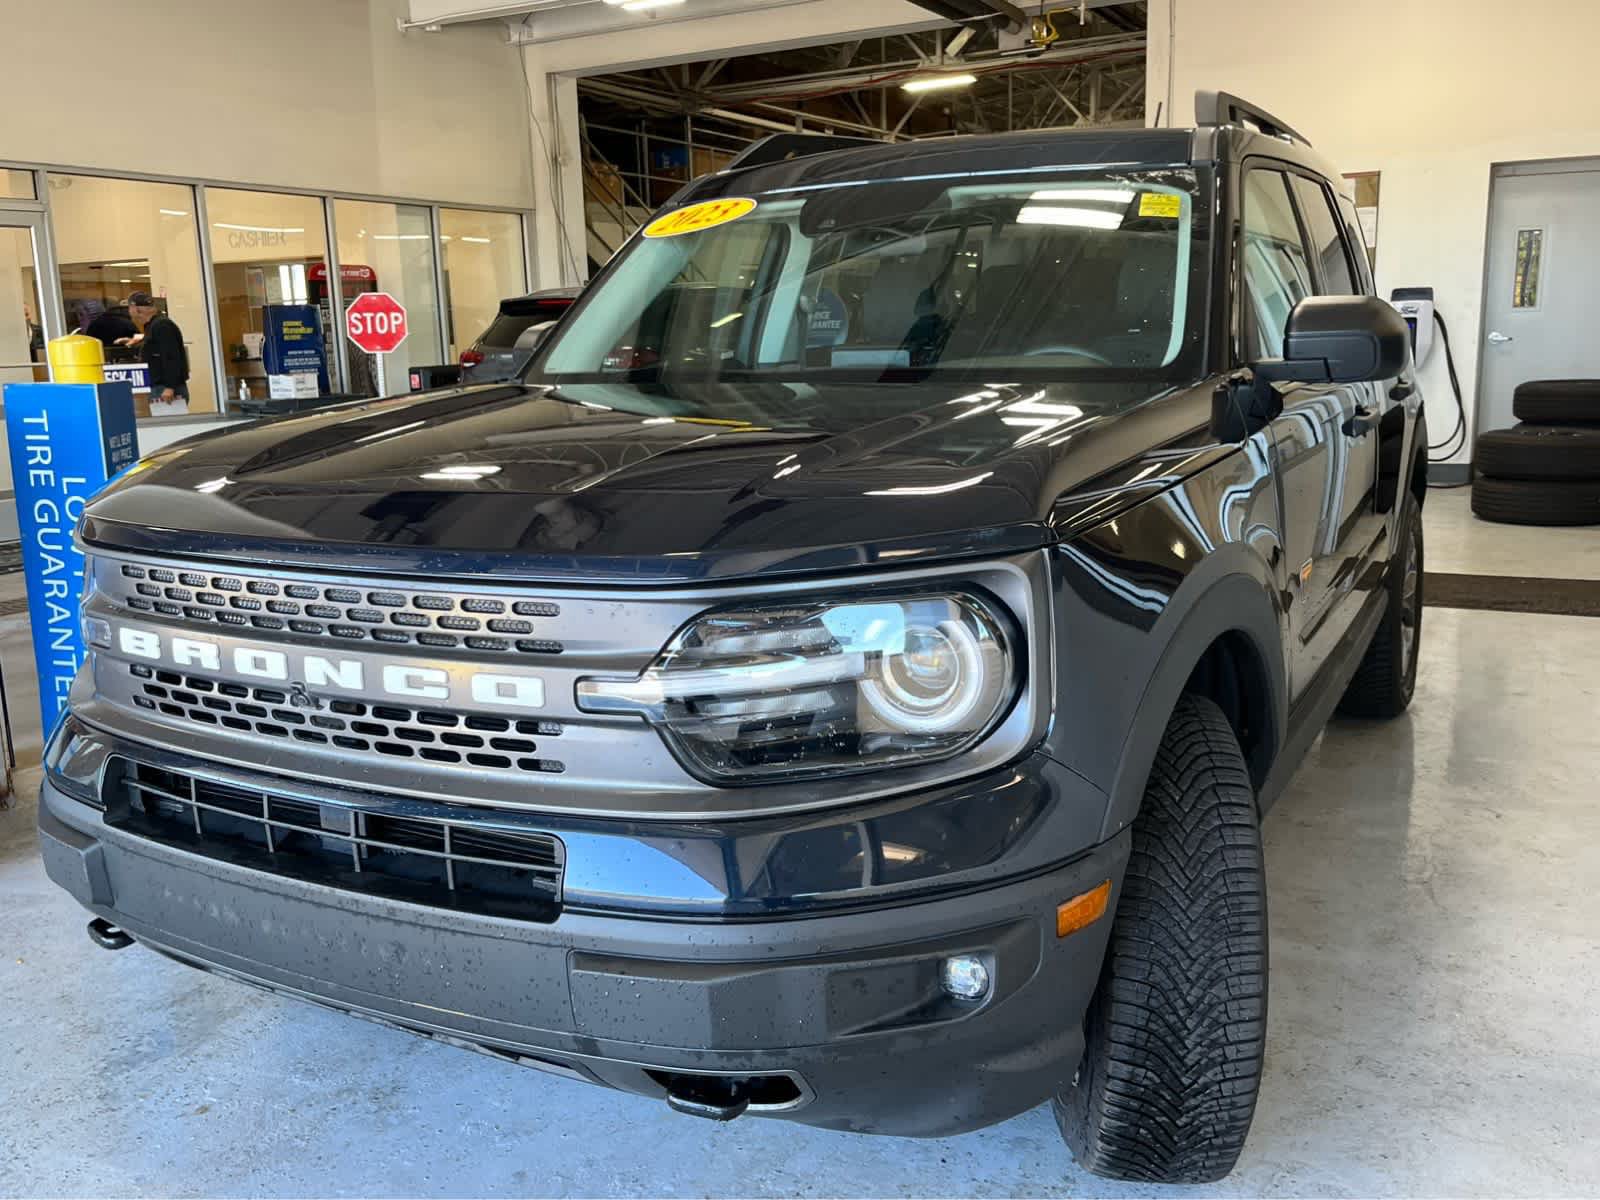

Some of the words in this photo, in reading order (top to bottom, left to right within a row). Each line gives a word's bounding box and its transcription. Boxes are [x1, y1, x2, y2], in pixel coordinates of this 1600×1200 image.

[228, 231, 288, 248] CASHIER
[350, 311, 403, 335] STOP
[104, 370, 145, 387] ECK-IN
[23, 409, 56, 487] TIRE
[119, 626, 546, 709] BRONCO
